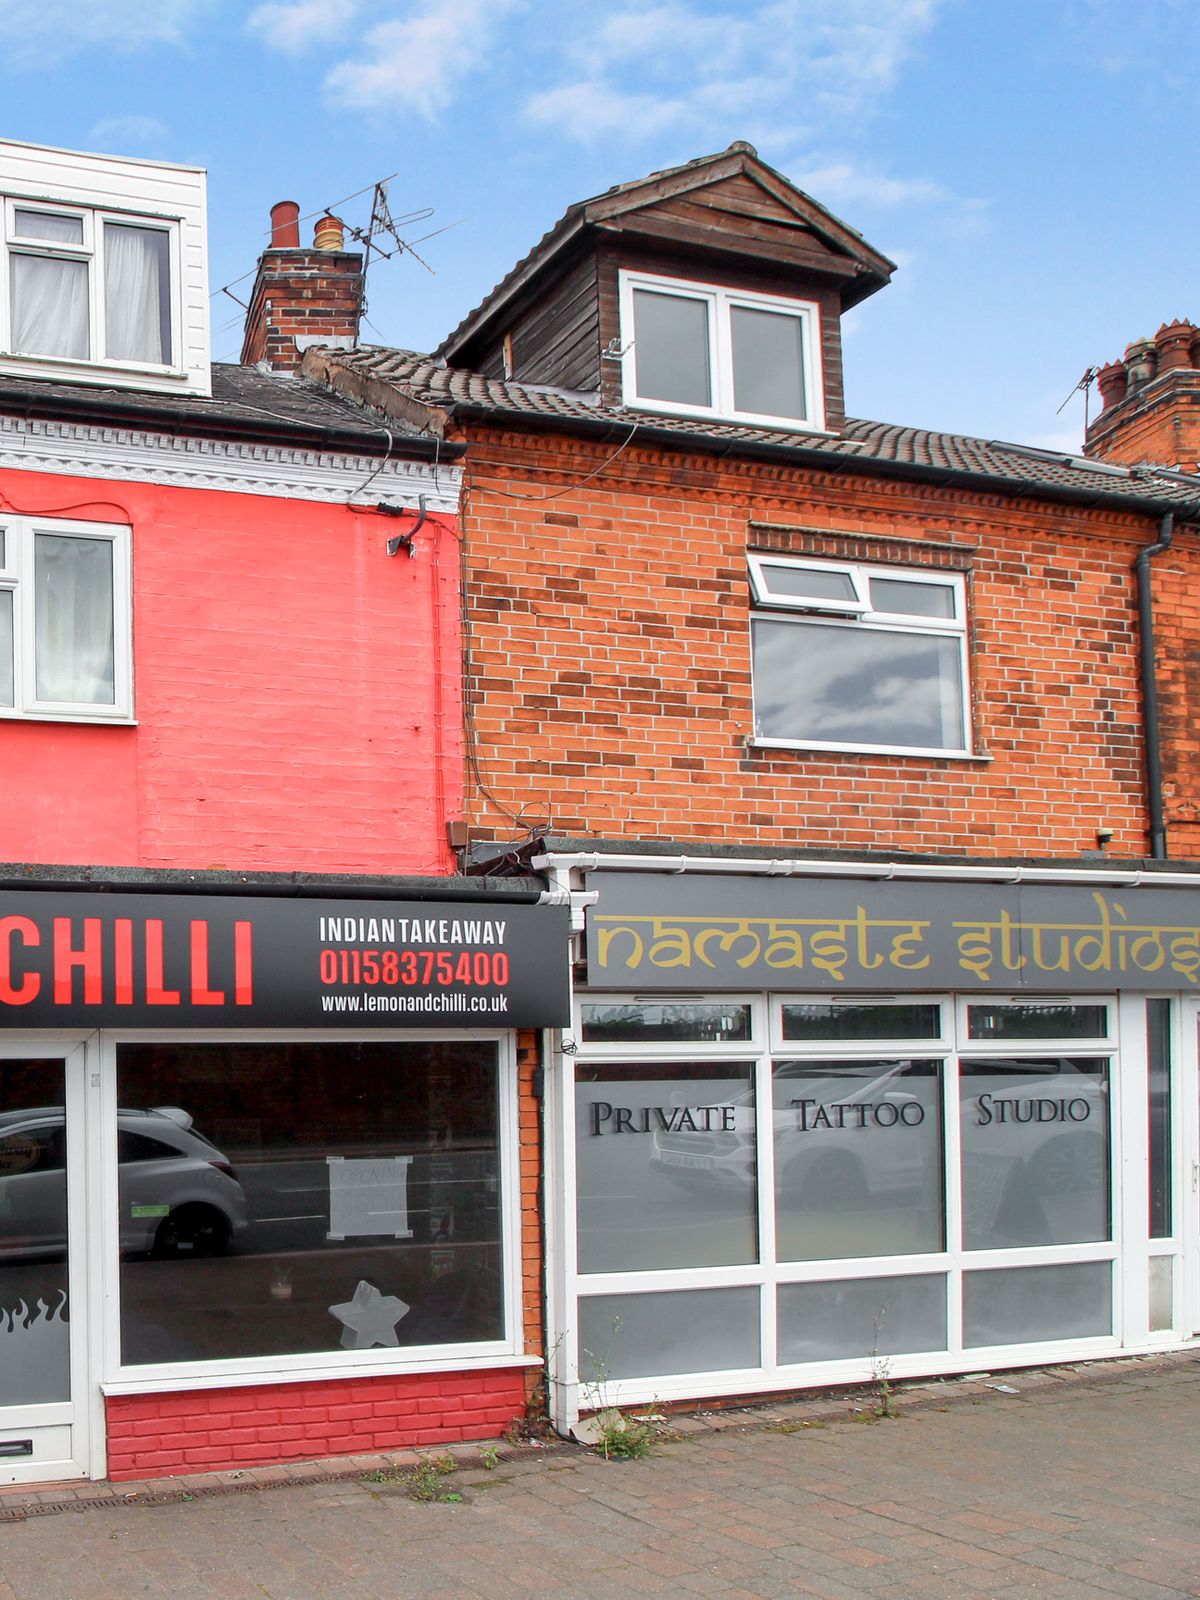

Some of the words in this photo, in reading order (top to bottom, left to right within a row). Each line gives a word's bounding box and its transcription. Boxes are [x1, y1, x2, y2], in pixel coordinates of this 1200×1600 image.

[319, 917, 396, 943] INDIAN
[398, 918, 507, 945] TAKEAWAY
[593, 905, 931, 981] namaste
[951, 892, 1200, 984] studios
[319, 949, 510, 986] 01158375400
[321, 992, 509, 1013] www.lemonandchilli.co.uk
